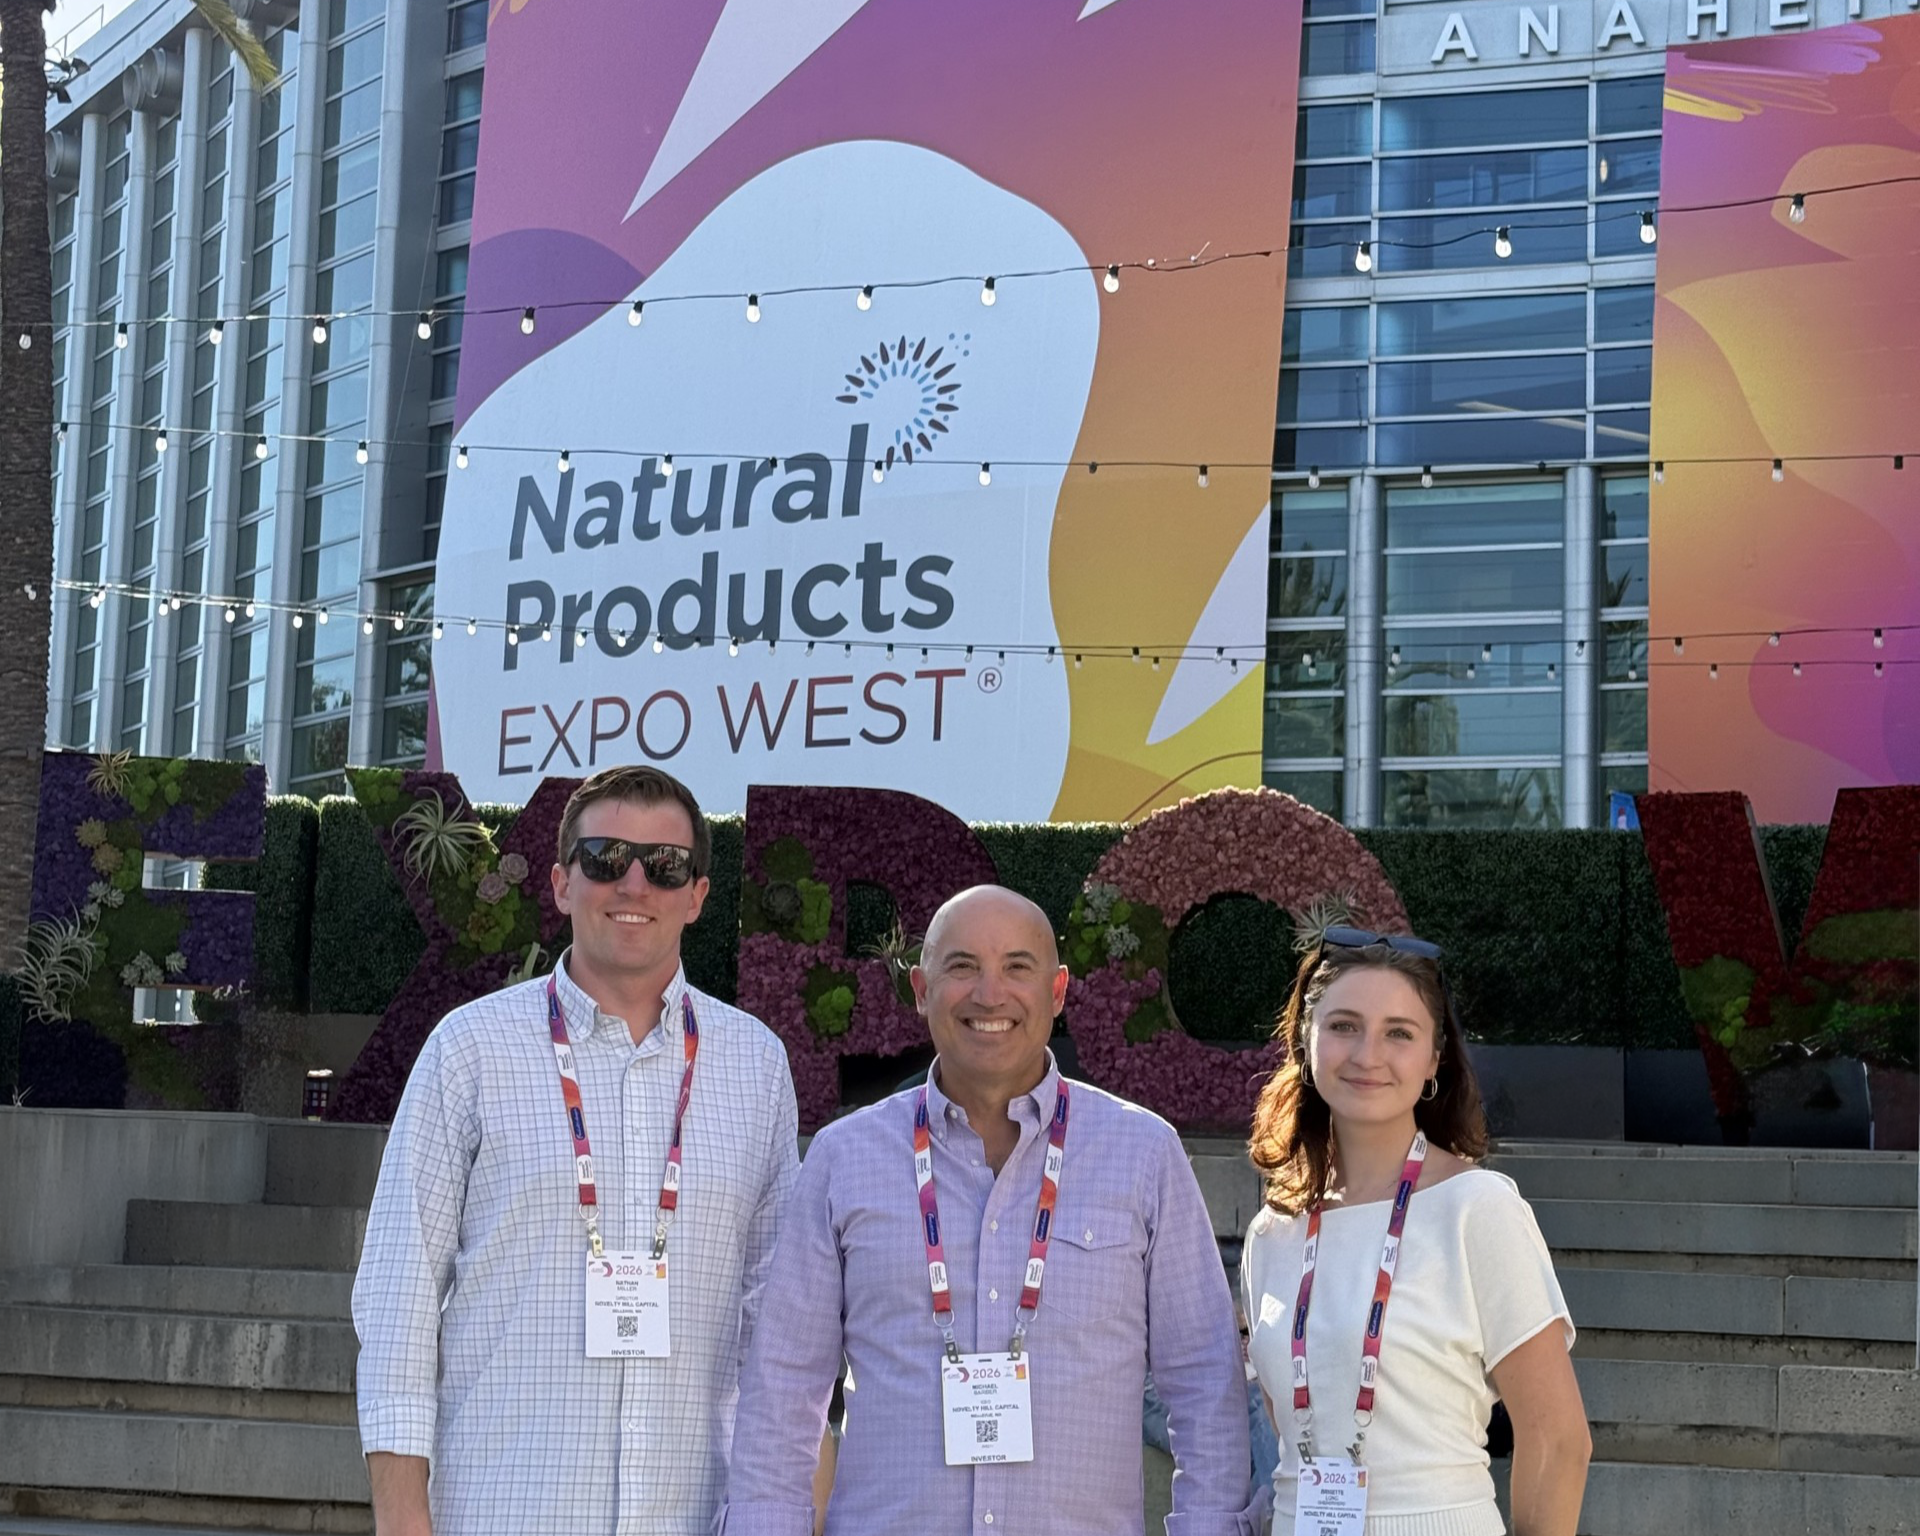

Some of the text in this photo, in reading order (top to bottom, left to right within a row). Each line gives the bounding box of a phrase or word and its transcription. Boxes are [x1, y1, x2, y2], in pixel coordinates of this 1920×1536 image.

[508, 423, 870, 561] Natural
[503, 542, 954, 671] Products
[498, 690, 692, 776] EXPO
[616, 1265, 643, 1276] 2026
[973, 1369, 1001, 1379] 2026
[1324, 1473, 1346, 1483] 2026
